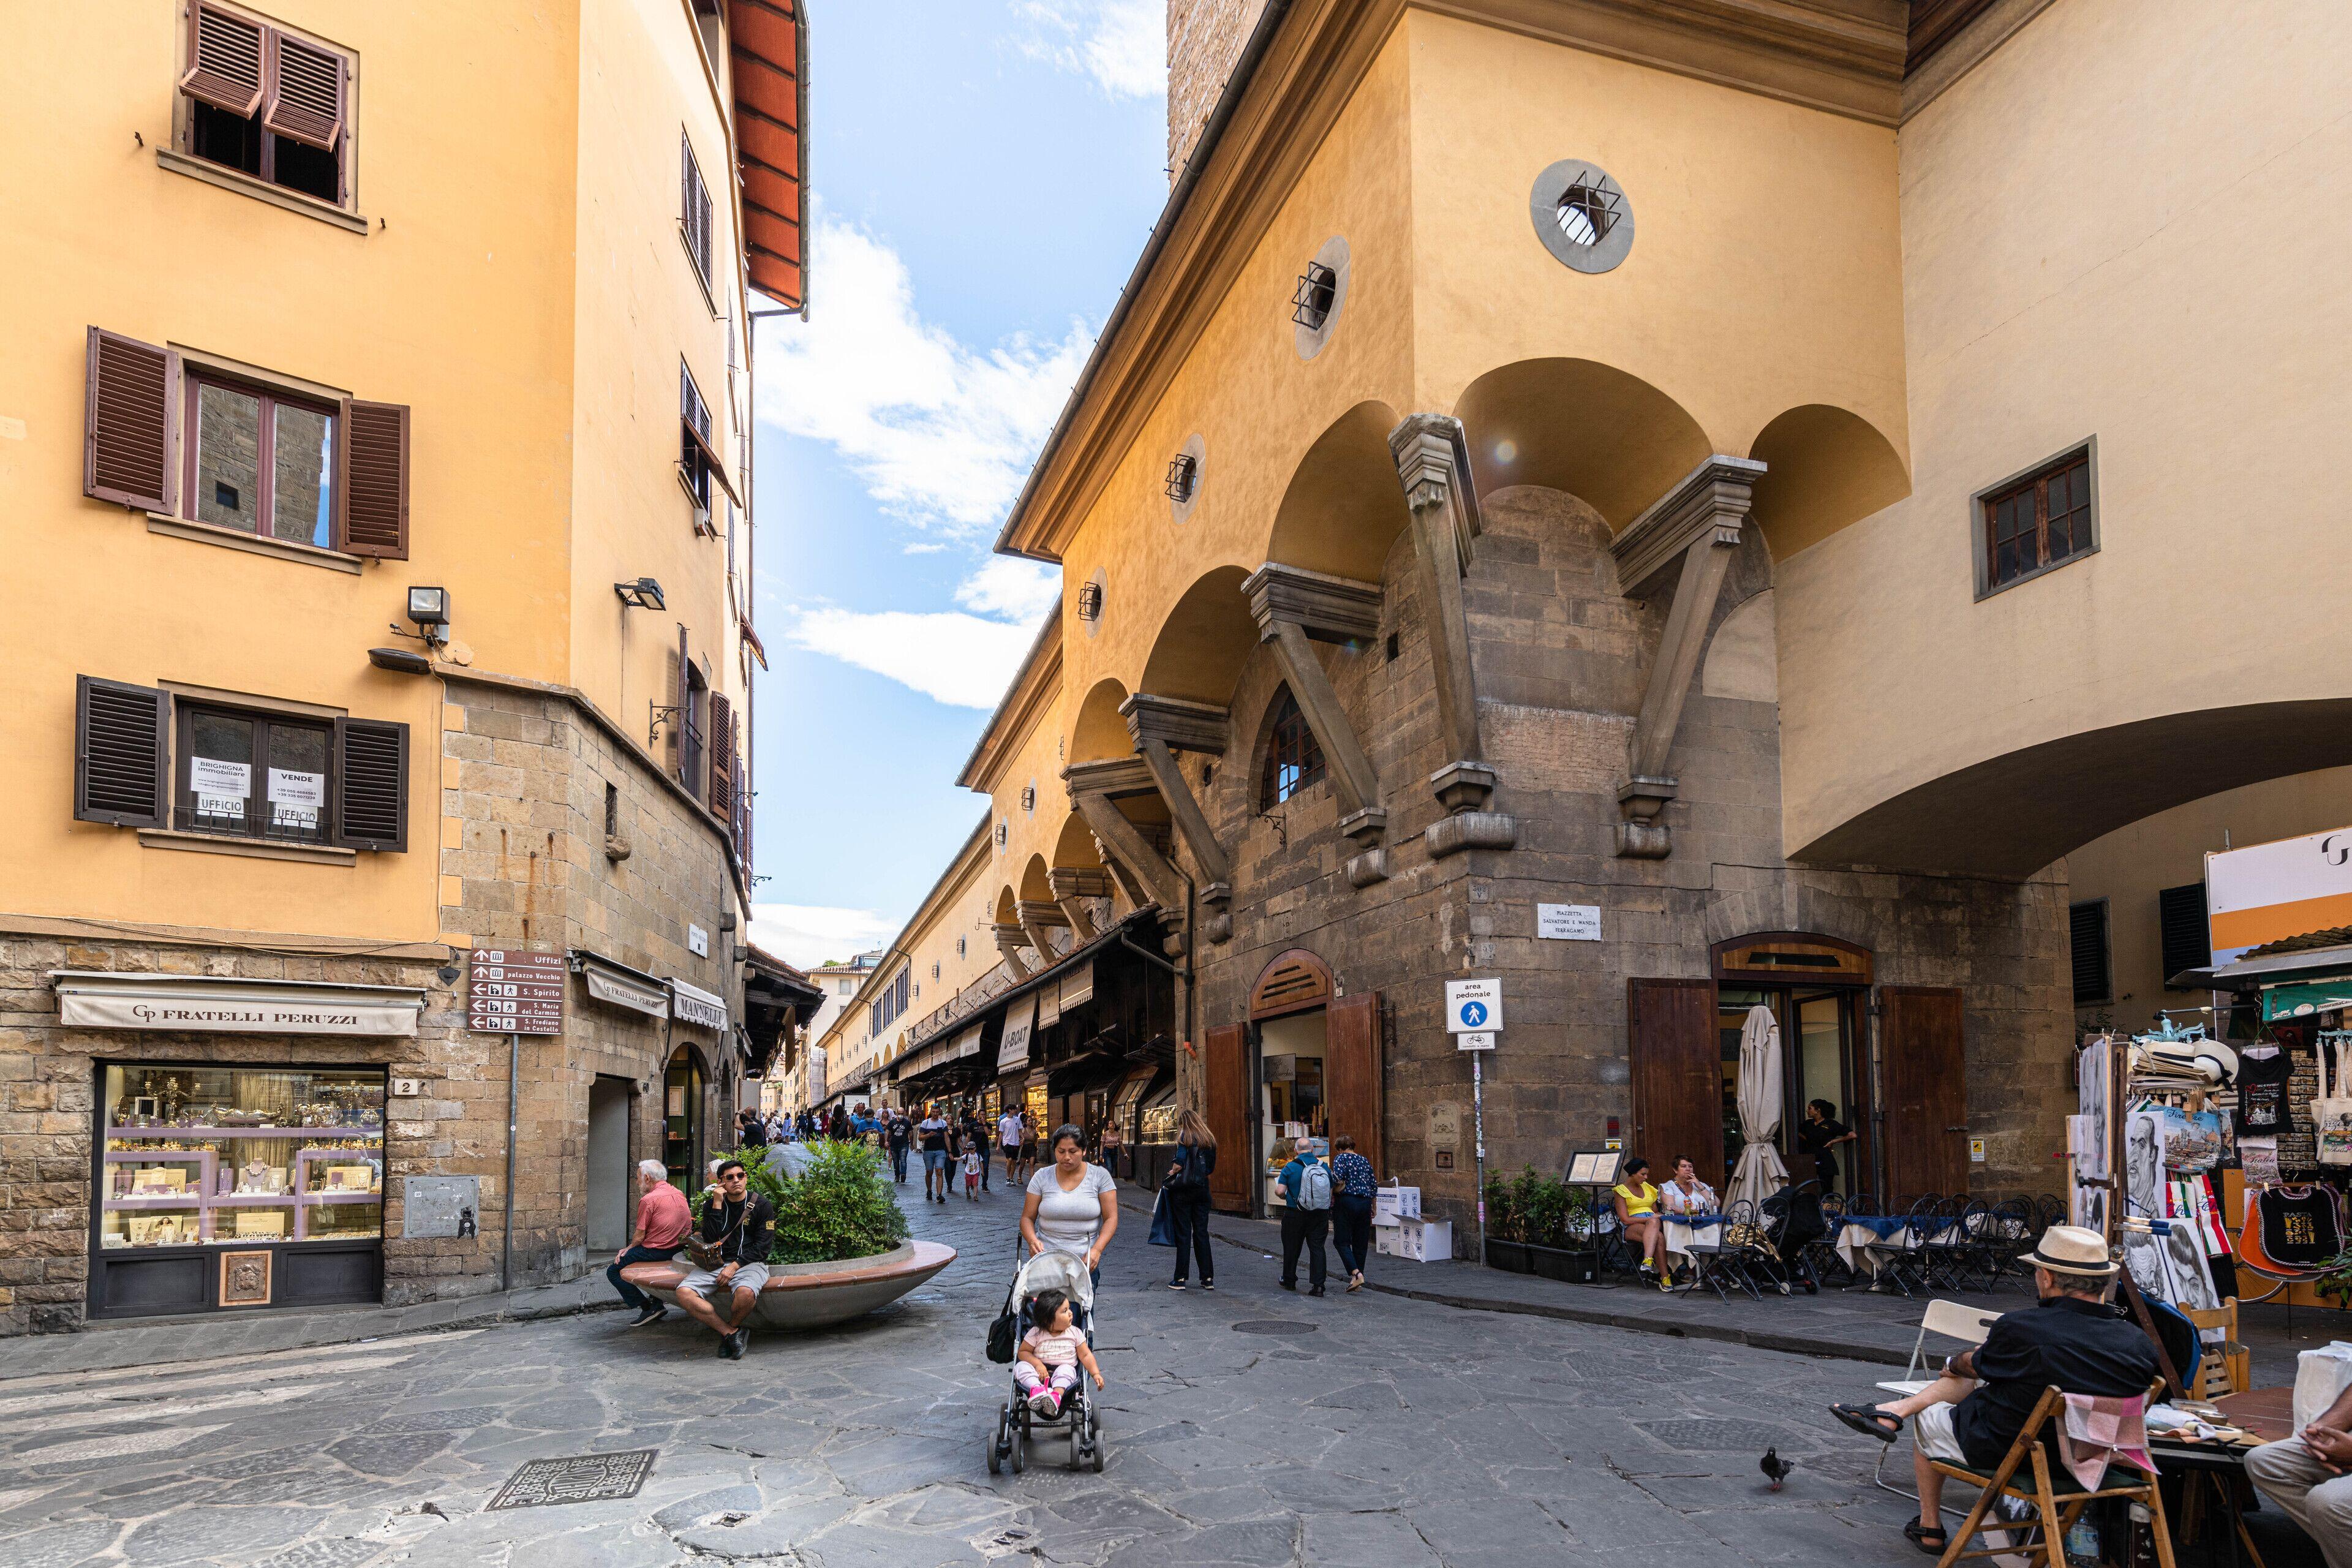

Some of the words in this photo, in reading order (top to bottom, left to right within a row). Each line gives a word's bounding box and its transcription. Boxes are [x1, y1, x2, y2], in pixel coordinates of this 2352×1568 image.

[198, 766, 245, 777] immobiliare
[200, 761, 243, 772] BRIGHIGNA
[281, 773, 313, 782] VENDE
[202, 799, 241, 812] UFFICIO
[278, 809, 315, 821] UFFICIO
[535, 956, 561, 965] Uffizi
[611, 986, 638, 1001] FRATELLI
[639, 996, 658, 1009] PERUZZI
[1456, 991, 1491, 1000] pedonale
[162, 1009, 264, 1022] FRATELLI
[273, 1013, 358, 1025] PERUZZI
[680, 998, 722, 1025] MANNELLI
[1005, 1025, 1028, 1049] U-BOAT
[402, 1082, 411, 1093] 2
[2166, 1109, 2204, 1121] Fireze
